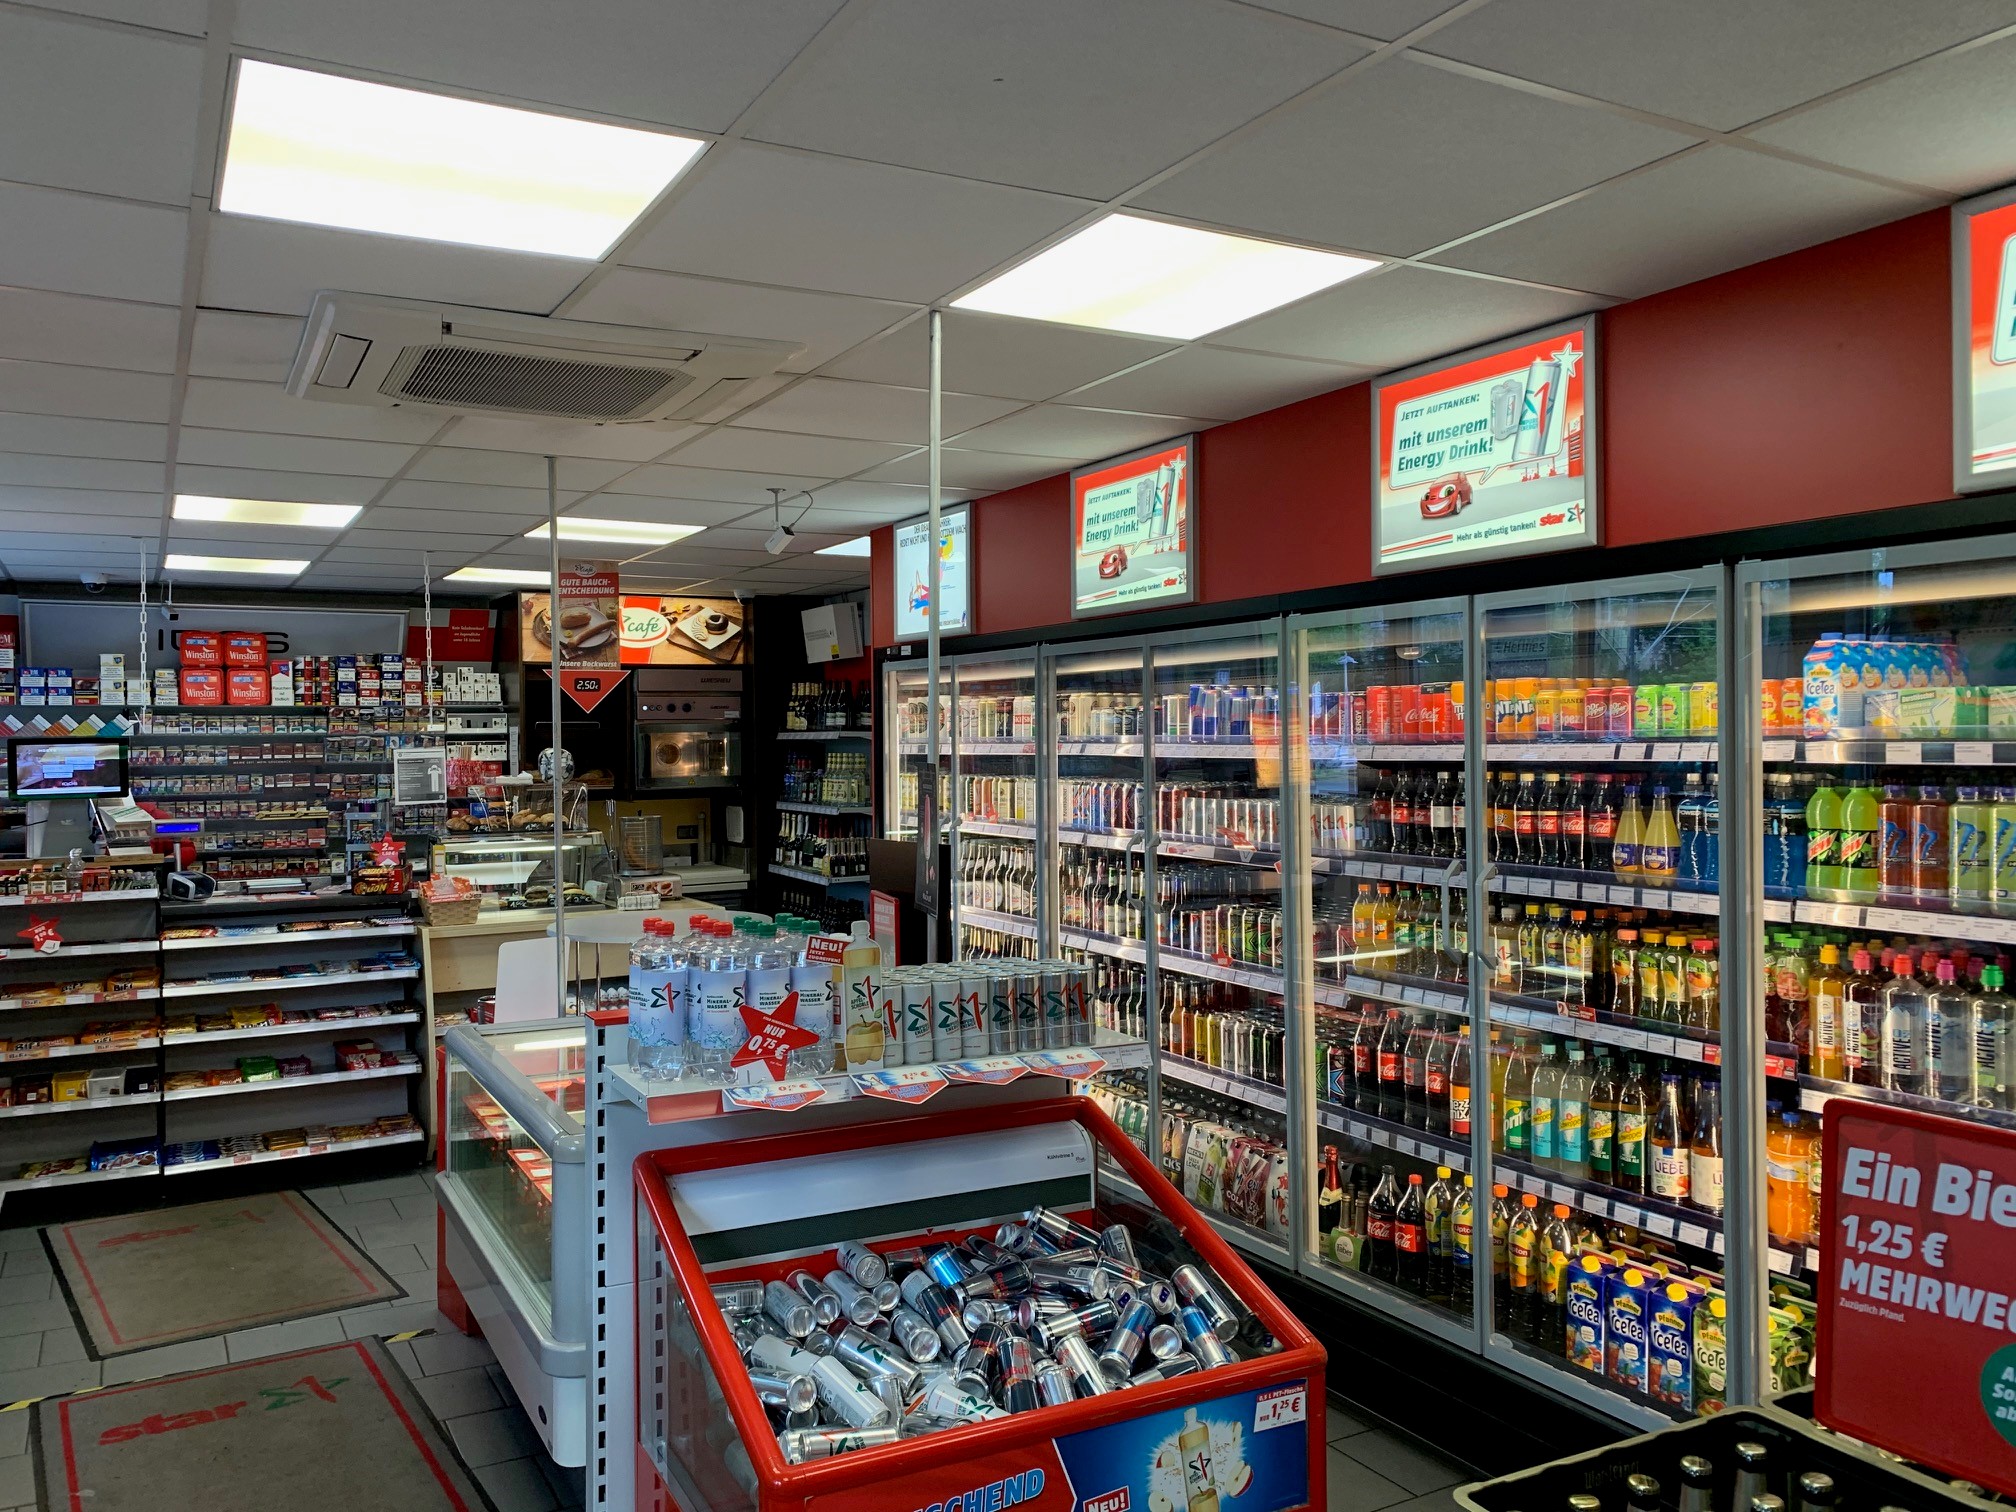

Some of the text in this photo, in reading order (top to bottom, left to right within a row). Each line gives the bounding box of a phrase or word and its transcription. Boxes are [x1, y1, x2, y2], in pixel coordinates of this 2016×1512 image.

[1400, 393, 1480, 422] JETZT AUFTANKEN:
[1398, 416, 1488, 450] mit unserem
[1398, 436, 1494, 472] Energy Drink!
[1087, 487, 1132, 506] JETZT AUFTANKEN:
[1086, 506, 1136, 526] mit unserem
[1539, 512, 1566, 527] star
[1086, 519, 1139, 543] Energy Drink!
[1456, 520, 1536, 542] Mehr als günstig tanken!
[561, 578, 611, 586] GUTE BAUCH-
[627, 618, 662, 638] café
[185, 649, 215, 659] Winston
[230, 650, 259, 660] Winston
[1504, 642, 1546, 654] Hermes
[582, 660, 618, 668] Bockwurst
[186, 688, 216, 698] Winston
[232, 688, 262, 698] Winston
[810, 938, 844, 954] NEU!
[763, 1024, 786, 1039] NUR
[748, 1036, 790, 1060] 0,75 €
[1893, 1038, 1911, 1070] ACTIVE
[1976, 1029, 1996, 1070] ACTIVE
[1654, 1159, 1685, 1174] LIEBE
[1842, 1146, 1922, 1208] Ein
[1226, 1190, 1244, 1208] COLA
[98, 1224, 200, 1248] star
[1841, 1215, 1948, 1268] 1,25 €
[1573, 1283, 1596, 1298] pfanner
[1569, 1294, 1600, 1324] iceTea
[1616, 1300, 1640, 1314] pfanner
[1840, 1297, 1906, 1322] Zuzüglich Pfand.
[1611, 1310, 1644, 1340] iceTea
[1658, 1315, 1684, 1330] pfanner
[1654, 1326, 1688, 1356] iceTea
[1273, 1386, 1304, 1398] PET-Flasche
[1272, 1400, 1290, 1420] 1,25
[1292, 1397, 1300, 1412] €
[99, 1401, 248, 1446] star
